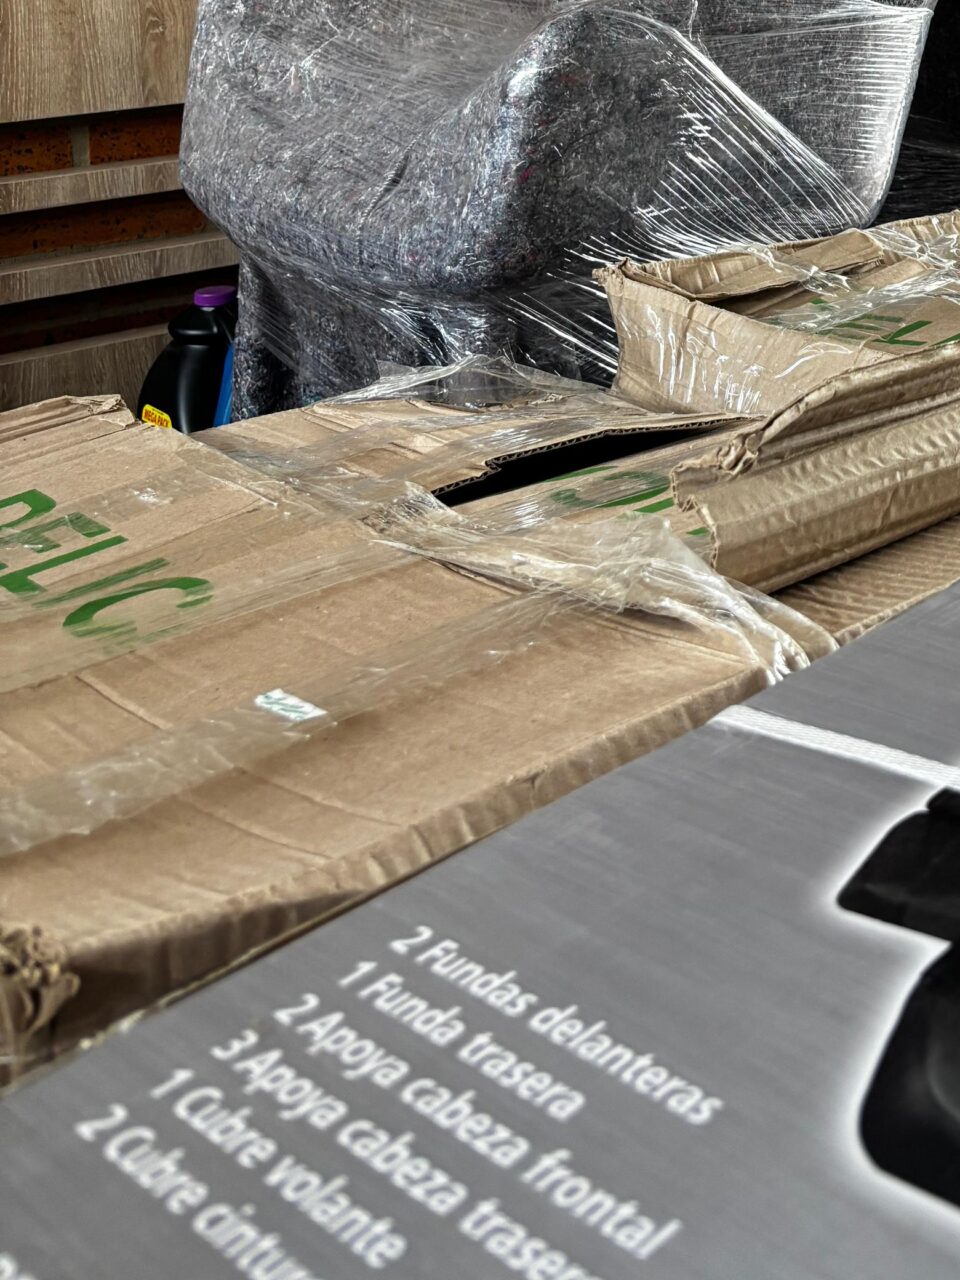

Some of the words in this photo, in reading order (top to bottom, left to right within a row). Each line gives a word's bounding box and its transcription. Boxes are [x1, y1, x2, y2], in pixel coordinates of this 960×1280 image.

[209, 1029, 259, 1062] 3
[273, 992, 321, 1026] 2
[296, 1010, 411, 1089] Apoya
[337, 960, 378, 989] 1
[358, 972, 466, 1047] Funda
[457, 1031, 586, 1122] trasera
[389, 924, 434, 955] 2
[414, 938, 539, 1018] Fundas
[528, 1004, 724, 1125] delanteras
[150, 1068, 196, 1100] 1
[172, 1085, 278, 1169] Cubre
[232, 1048, 349, 1130] Apoya
[400, 1077, 532, 1169] cabeza
[74, 1102, 130, 1143] 2
[103, 1124, 209, 1216] Cubre
[191, 1202, 322, 1280] cintu
[336, 1118, 469, 1216] cabeza
[519, 1148, 683, 1260] frontal
[262, 1155, 408, 1270] volante
[457, 1196, 606, 1280] traser
